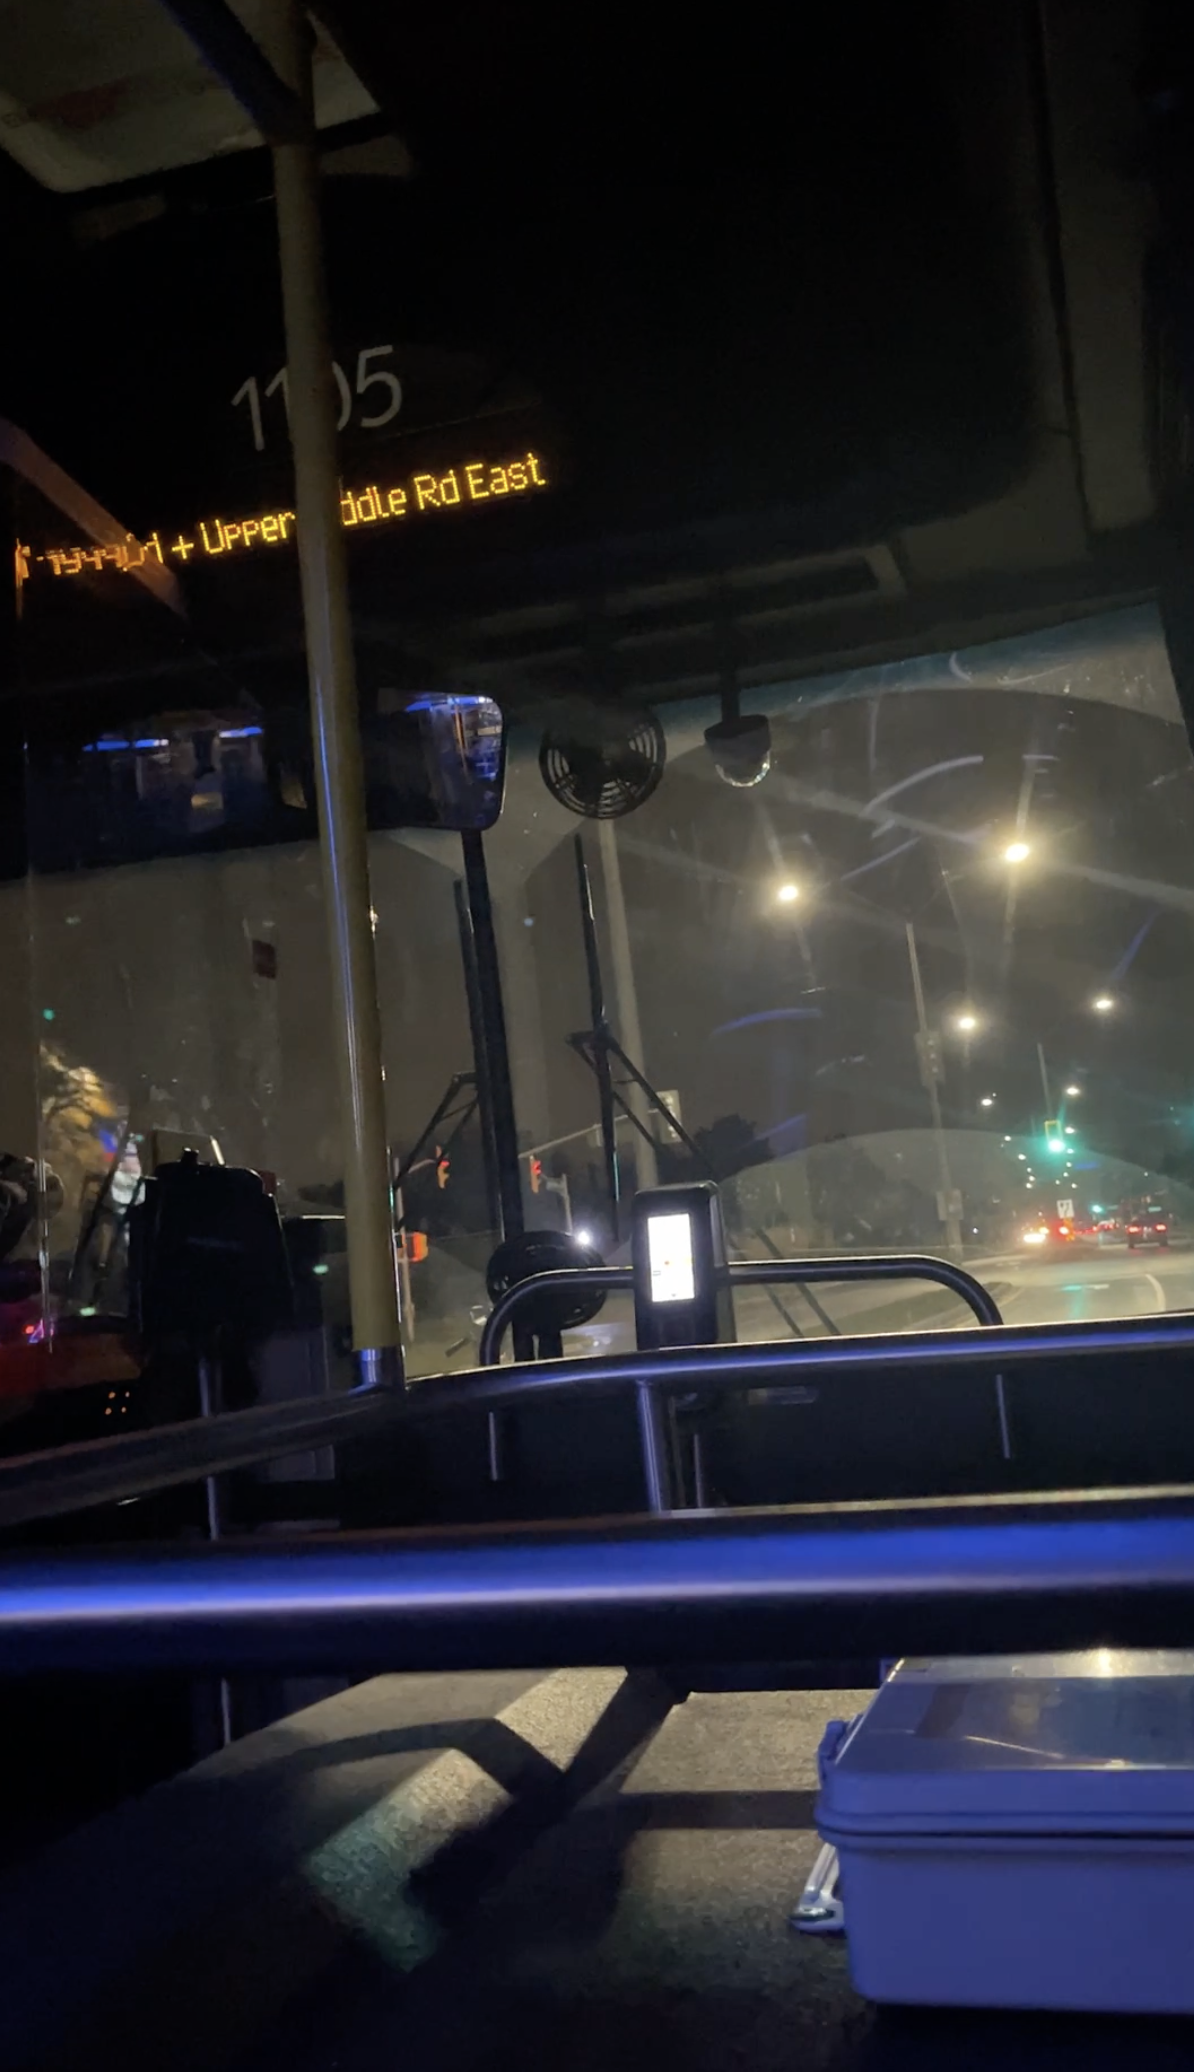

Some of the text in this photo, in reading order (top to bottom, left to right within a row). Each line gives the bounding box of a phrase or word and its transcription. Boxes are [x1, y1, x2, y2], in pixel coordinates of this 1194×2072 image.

[200, 511, 296, 554] Upper
[340, 485, 407, 526] ddle
[413, 469, 460, 510] Rd
[465, 452, 546, 499] East
